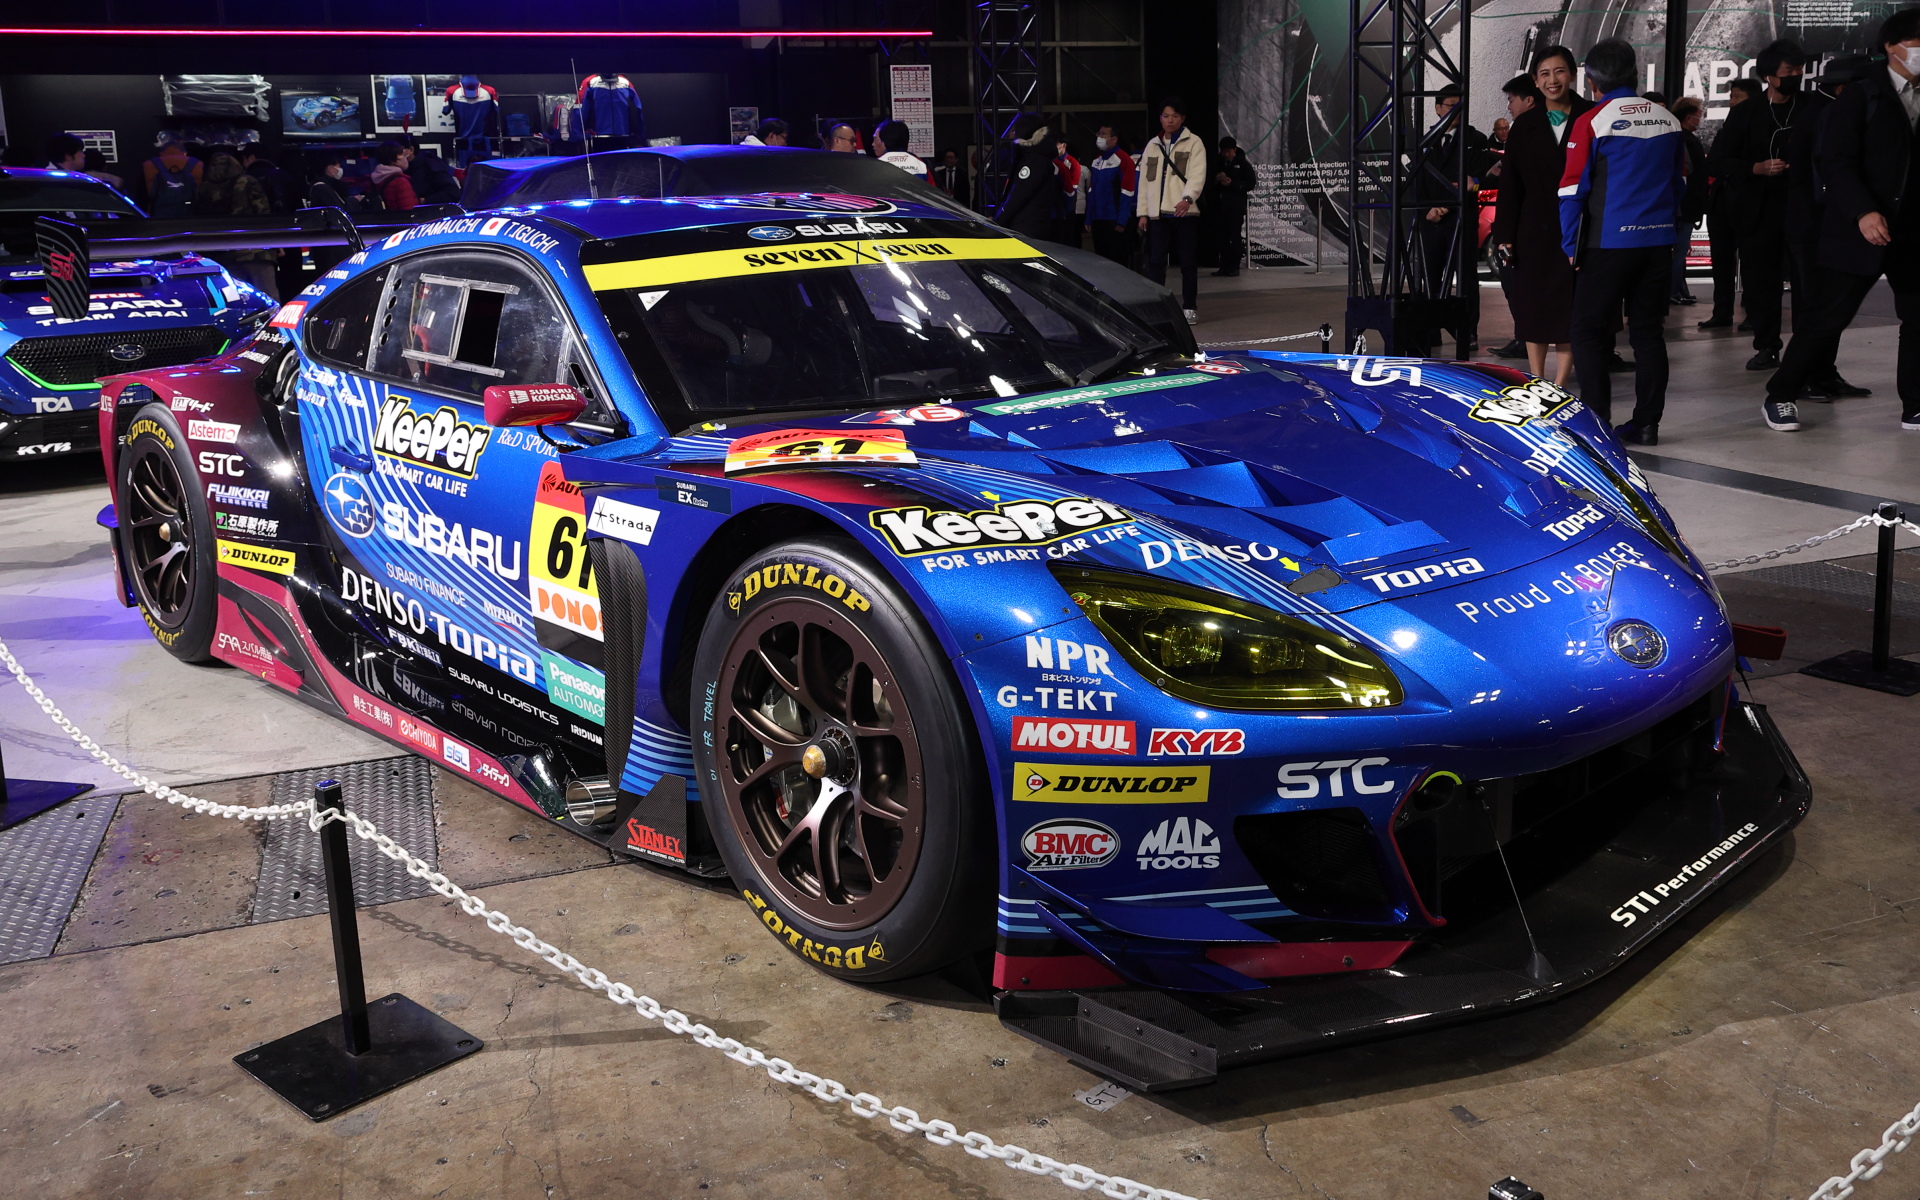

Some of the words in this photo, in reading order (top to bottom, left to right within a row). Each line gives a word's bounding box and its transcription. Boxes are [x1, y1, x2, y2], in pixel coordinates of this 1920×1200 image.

[1633, 118, 1672, 128] SUBARU
[1320, 161, 1347, 169] injection
[1366, 160, 1389, 168] engine
[1297, 186, 1321, 194] manual
[404, 218, 482, 241] H.YAMAUCHI
[503, 221, 560, 254] T.IGUCHI
[795, 222, 908, 237] SUBARU
[743, 243, 843, 268] seven
[872, 241, 955, 258] seven
[27, 299, 183, 316] SBARU
[32, 397, 74, 414] TOA
[531, 393, 577, 403] KOHSAN
[993, 388, 1110, 415] Panasonic
[1110, 374, 1216, 393] AUTOMOTIVE
[131, 419, 175, 450] DUNLOP
[190, 423, 236, 441] Astemo
[375, 396, 491, 473] KeePer
[497, 428, 523, 447] R&D
[17, 441, 72, 455] KYB
[199, 451, 245, 477] STC
[207, 483, 270, 502] FUJIKIKAI
[394, 464, 423, 485] SMART
[425, 473, 442, 491] CAR
[445, 478, 468, 498] LIFE
[676, 482, 697, 491] SUBARU
[678, 490, 693, 504] EX
[228, 513, 279, 533] 石原製作所
[609, 513, 653, 532] Strada
[880, 498, 1127, 552] KeePer
[383, 501, 521, 581] SUBARU
[922, 553, 969, 573] FOR
[976, 547, 1041, 567] SMART
[1046, 537, 1088, 560] CAR
[1098, 524, 1142, 545] LIFE
[231, 548, 289, 567] DUNLOP
[1138, 541, 1280, 571] DENSO
[386, 562, 423, 591] SUBARU
[424, 577, 467, 608] FINANCE
[744, 563, 872, 613] DUNLOP
[1455, 582, 1553, 624] Proud
[1552, 571, 1584, 595] of
[1574, 541, 1645, 584] BOXER
[341, 566, 426, 635] DENSO
[483, 600, 523, 628] MIZUHO
[1025, 636, 1114, 676] NPR
[1042, 673, 1102, 686] 日本ピストンリング
[448, 667, 494, 695] SUBARU
[497, 686, 559, 726] LOGISTICS
[703, 681, 717, 722] TRAVEL
[997, 685, 1118, 712] G-TEKT
[408, 722, 437, 751] CHIYODA
[571, 723, 603, 746] IRIDIUM
[1017, 721, 1131, 750] MOTUL
[1147, 728, 1245, 756] KYB
[1053, 776, 1198, 793] DUNLOP
[1277, 756, 1395, 799] STC
[627, 818, 684, 858] STANLEY
[1033, 832, 1109, 855] BMC
[1137, 817, 1221, 856] MAC
[1033, 855, 1070, 867] Air
[1069, 854, 1101, 865] Filter
[1136, 855, 1221, 870] TOOLS
[1610, 890, 1661, 928] STI
[1653, 822, 1759, 898] Performance
[744, 889, 868, 970] DUNLOP
